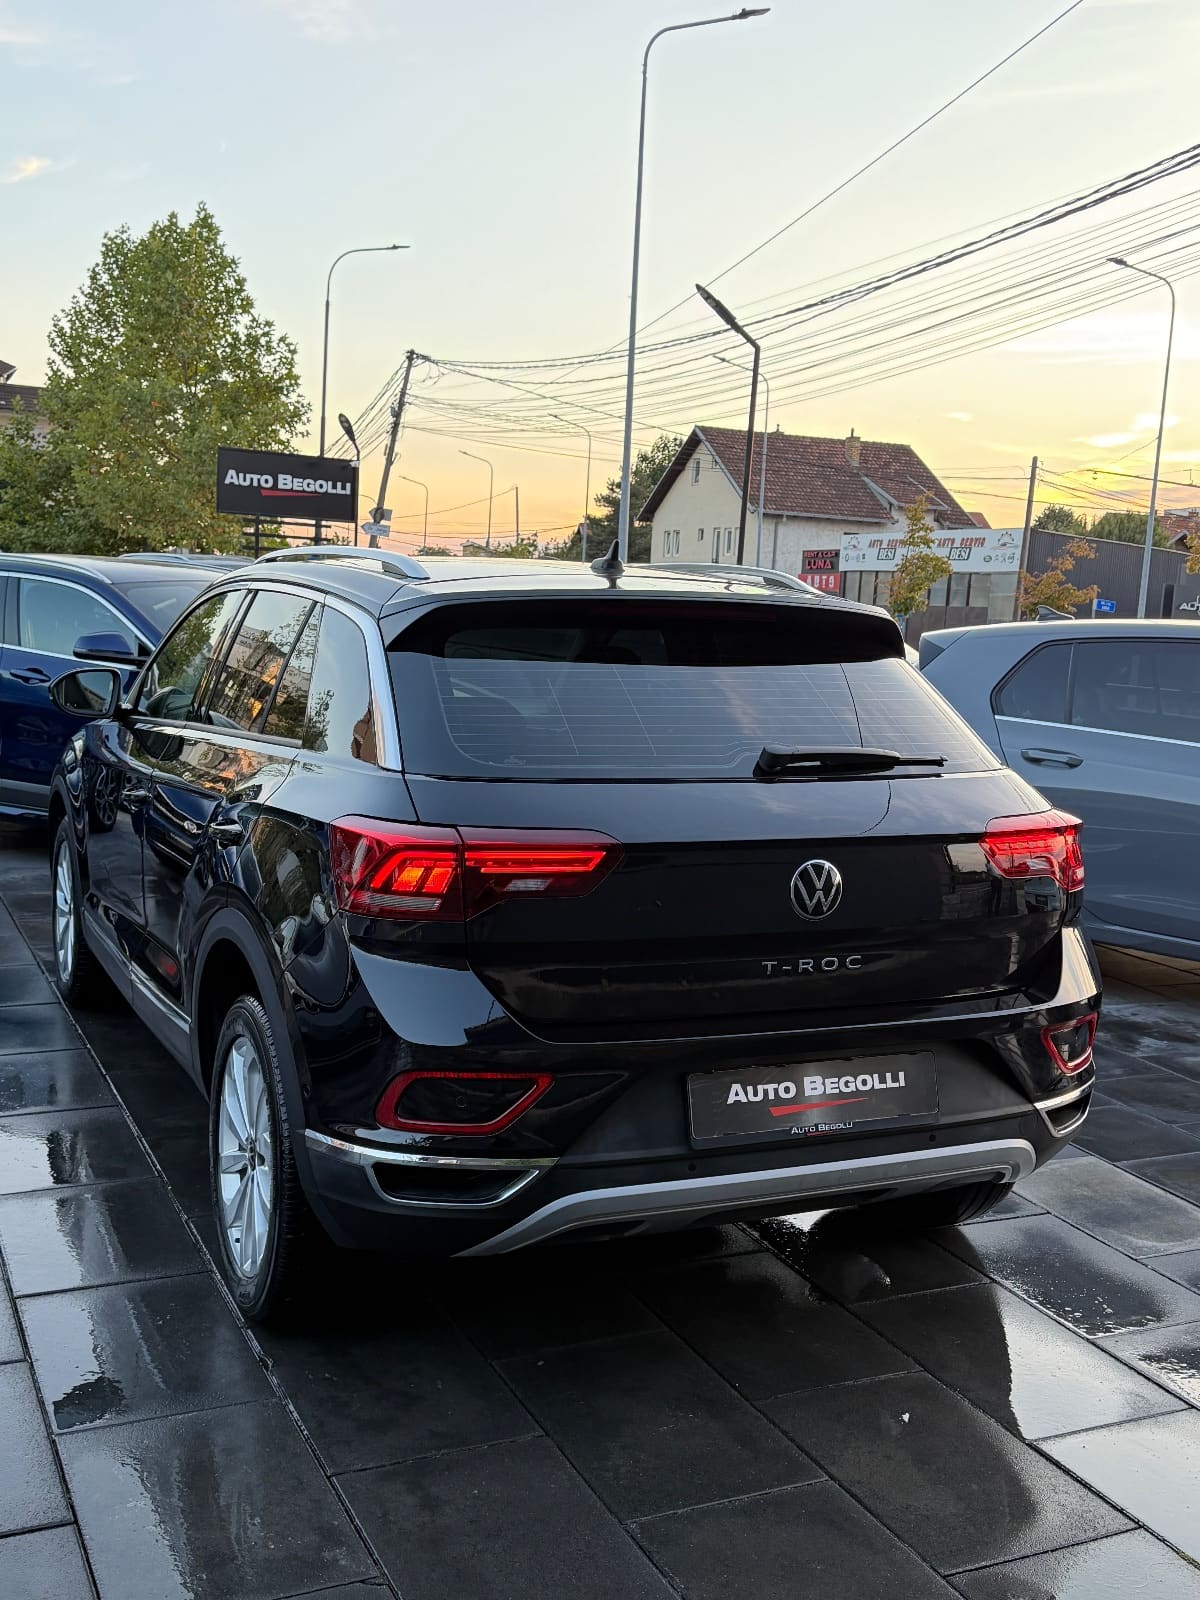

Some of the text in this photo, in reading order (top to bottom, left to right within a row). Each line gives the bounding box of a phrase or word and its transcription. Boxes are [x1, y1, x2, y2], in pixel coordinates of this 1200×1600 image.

[224, 469, 351, 495] AUTO BEGOLLI
[949, 547, 970, 560] BESI
[805, 559, 832, 569] LUNA
[806, 575, 835, 588] AUTO
[761, 955, 862, 976] T-ROC
[726, 1070, 907, 1105] AUTO BEGOLLI
[791, 1126, 816, 1135] AUTO
